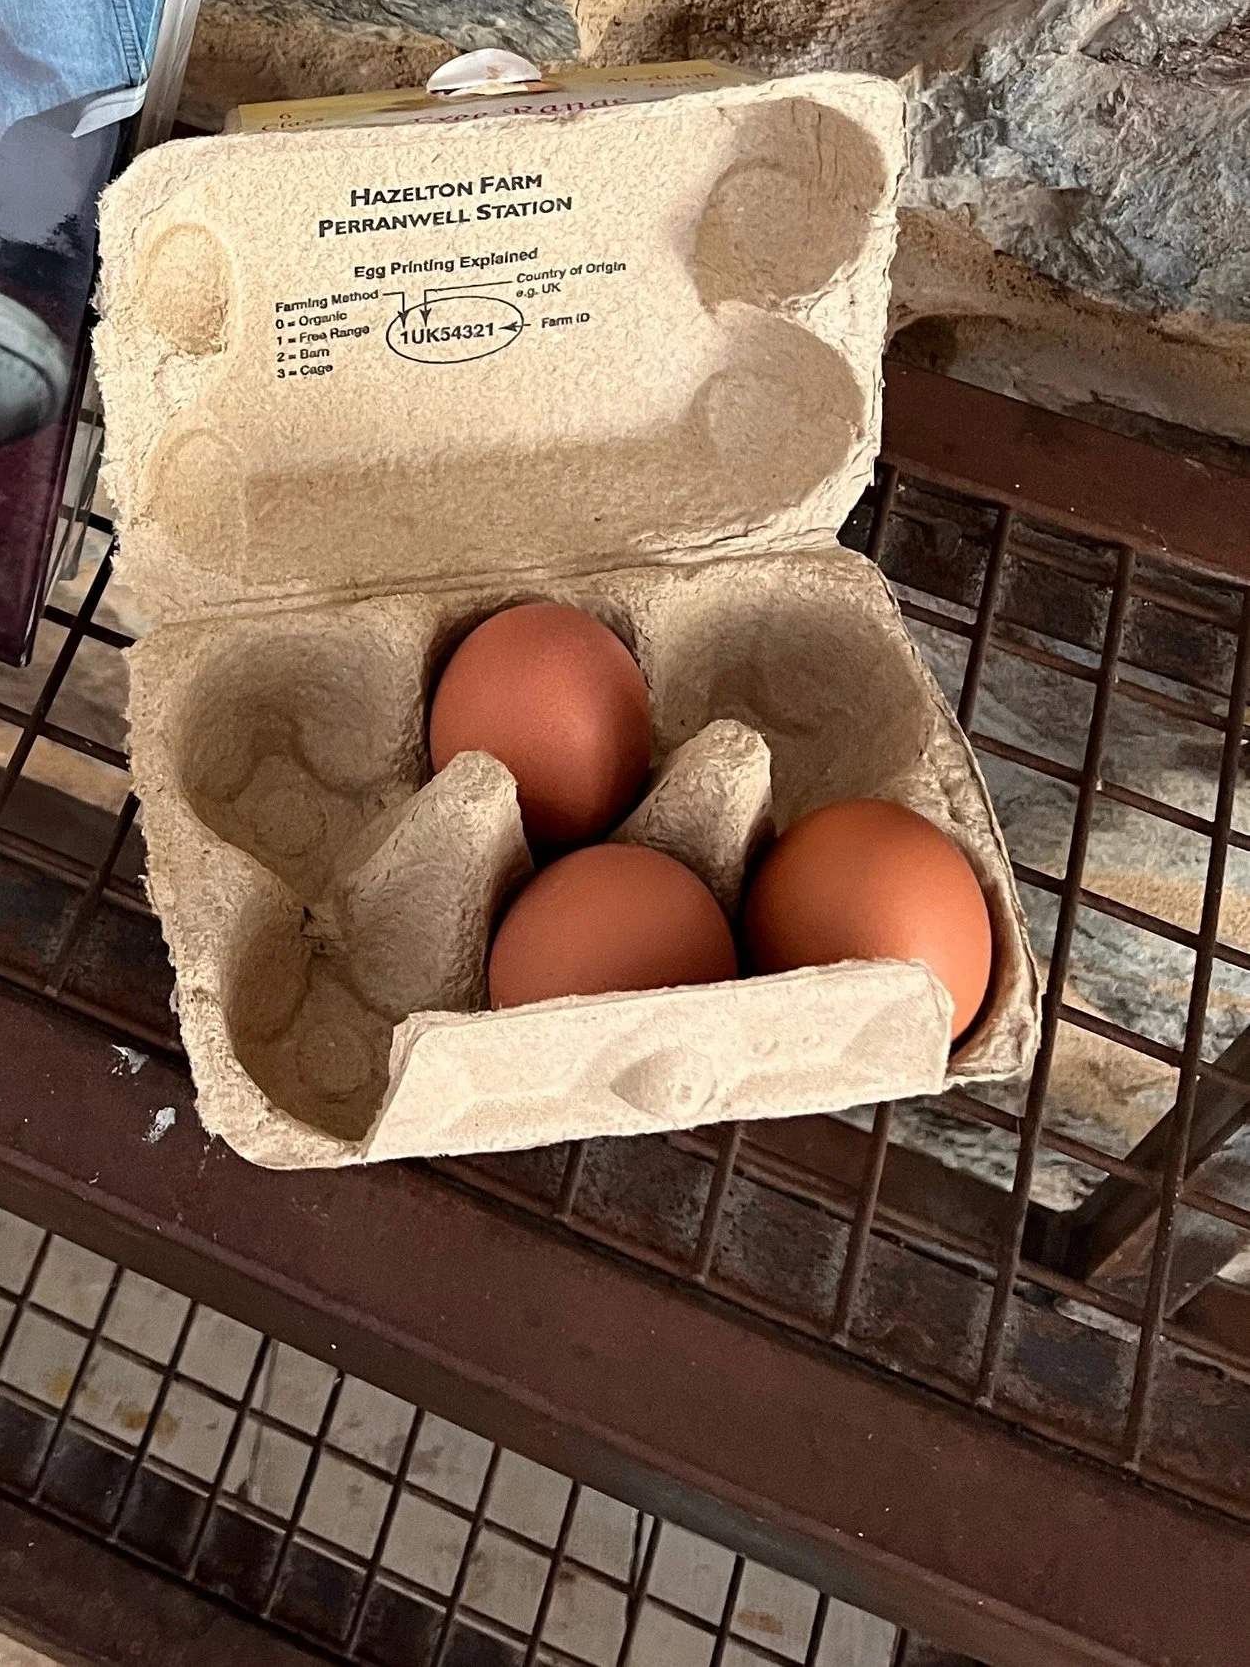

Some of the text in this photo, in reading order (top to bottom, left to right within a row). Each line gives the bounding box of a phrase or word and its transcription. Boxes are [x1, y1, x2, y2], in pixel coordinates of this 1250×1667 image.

[350, 174, 542, 207] HAZELTON FARM
[318, 196, 572, 237] PERRANWELL STATION
[354, 247, 538, 279] Egg Printing Explained
[516, 261, 627, 284] Country of Origin
[275, 290, 379, 313] Farming Method
[516, 282, 561, 299] e.g. UK
[299, 311, 348, 326] Organic
[541, 312, 590, 328] Farm ID
[276, 336, 282, 346] 1
[299, 332, 327, 343] Free
[330, 325, 370, 339] Range
[400, 322, 494, 345] 1UK54321
[276, 352, 285, 362] 2
[299, 348, 330, 359] Barn
[276, 368, 285, 378] 3
[299, 364, 333, 376] Cage
